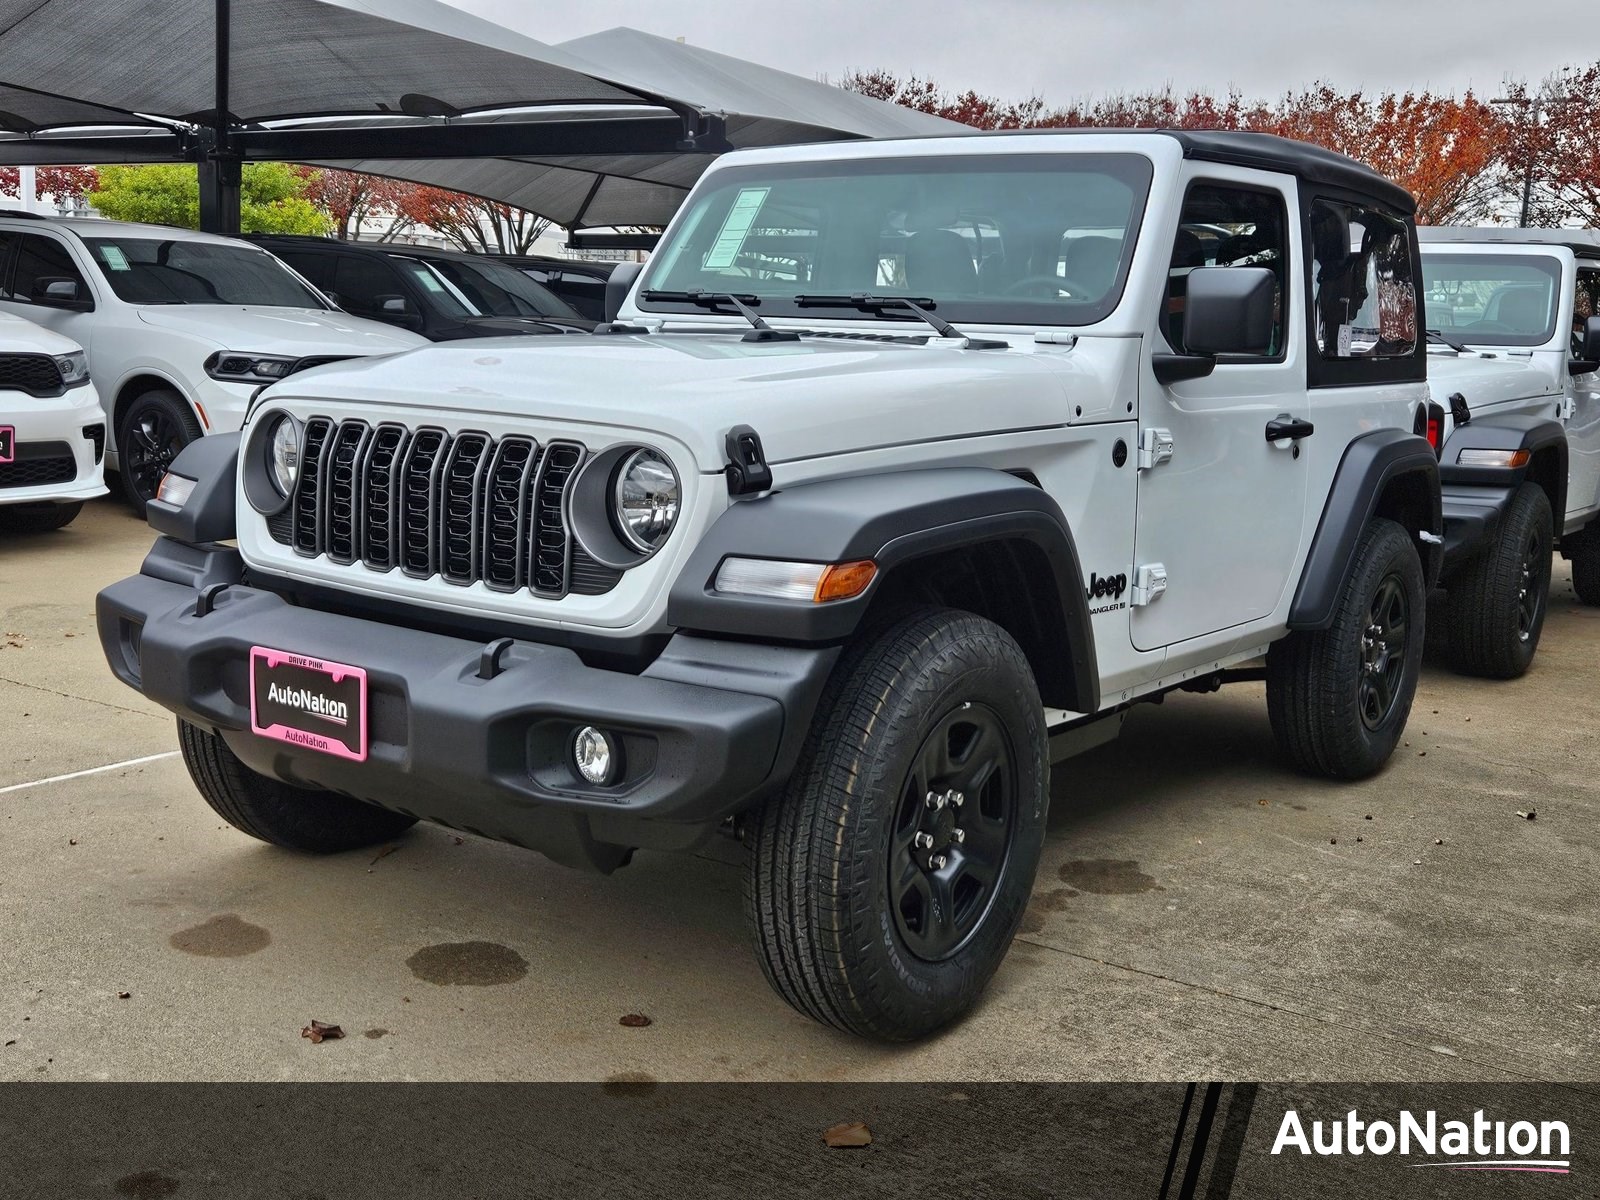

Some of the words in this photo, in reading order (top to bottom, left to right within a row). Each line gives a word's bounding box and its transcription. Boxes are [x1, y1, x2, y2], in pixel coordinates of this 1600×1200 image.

[1086, 572, 1127, 600] Jeep
[1089, 603, 1119, 615] ANGLER
[288, 655, 307, 666] DRIVE
[308, 660, 323, 670] PINK
[268, 682, 348, 718] AutoNation
[285, 730, 328, 750] AutoNation
